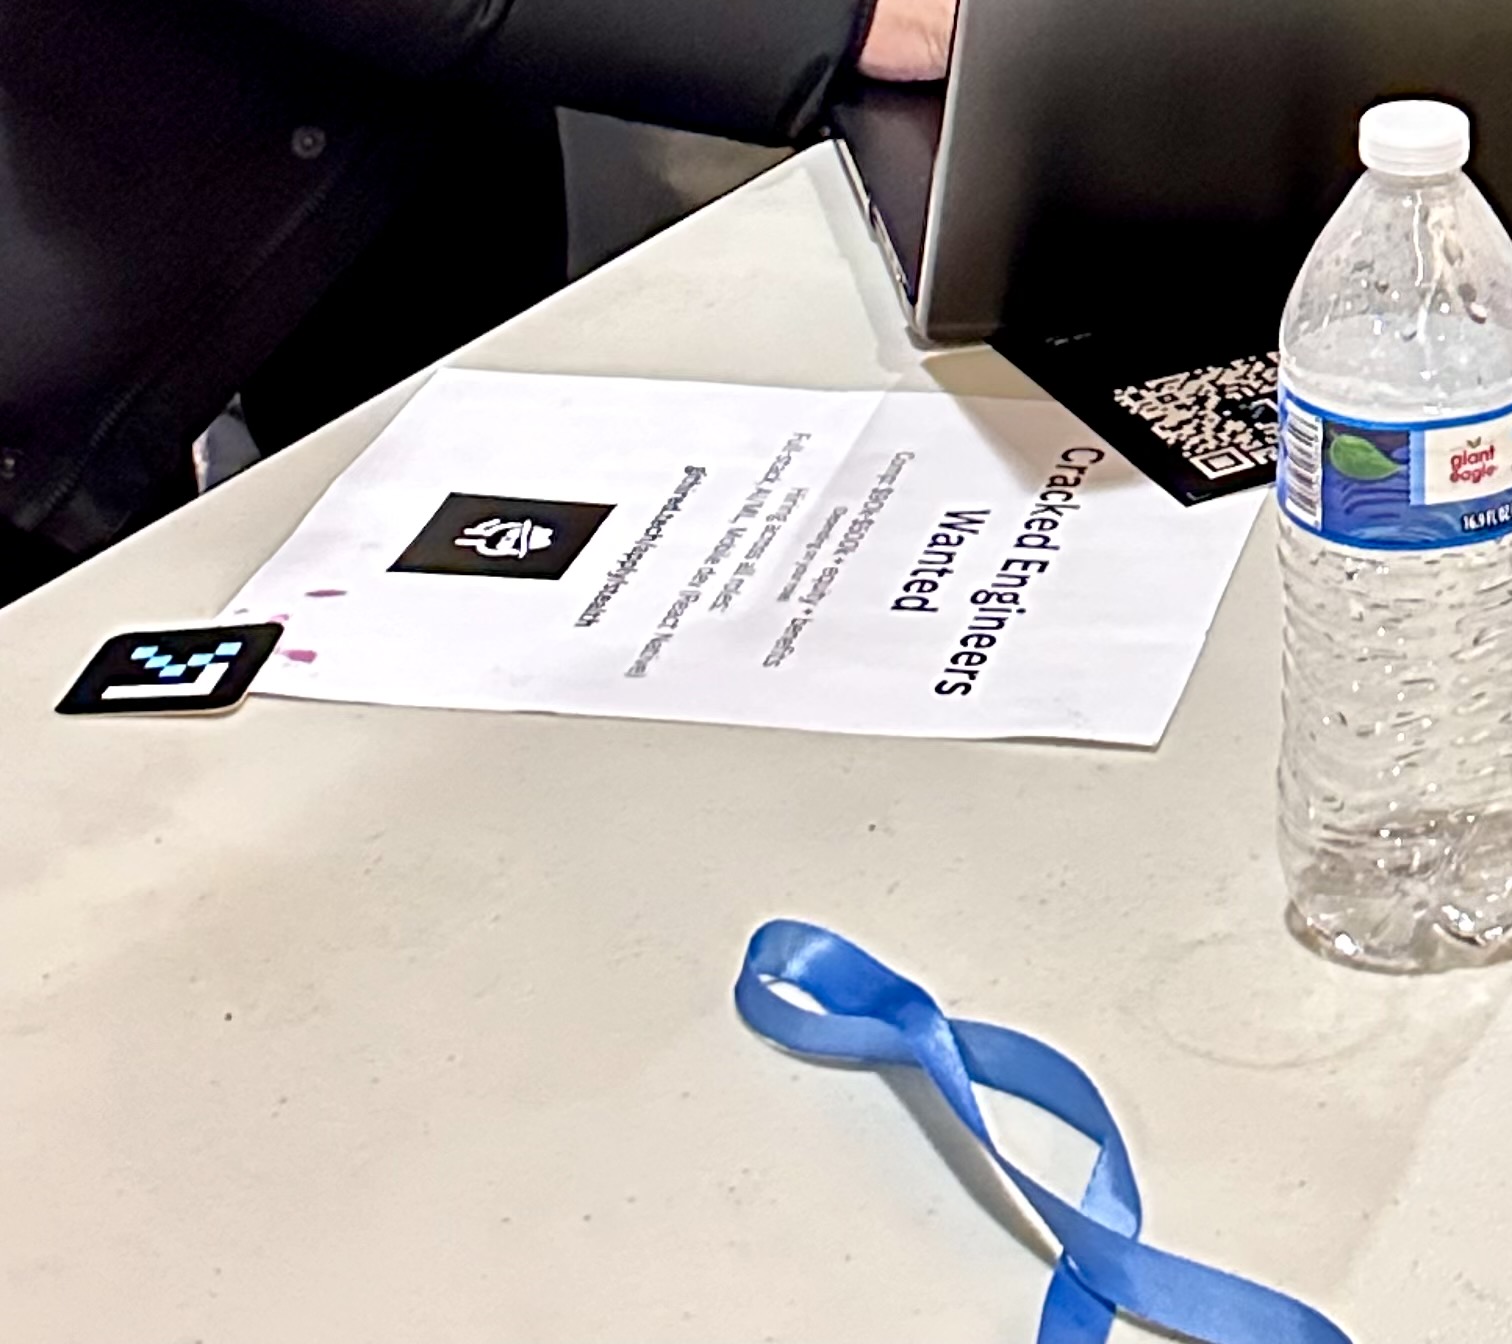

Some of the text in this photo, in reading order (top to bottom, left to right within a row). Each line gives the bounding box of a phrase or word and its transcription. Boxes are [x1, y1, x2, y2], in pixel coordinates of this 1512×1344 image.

[1014, 447, 1105, 551] Cracked
[797, 566, 839, 607] equity
[891, 509, 991, 612] Wanted
[762, 617, 814, 668] benefits
[935, 558, 1049, 696] Engineers
